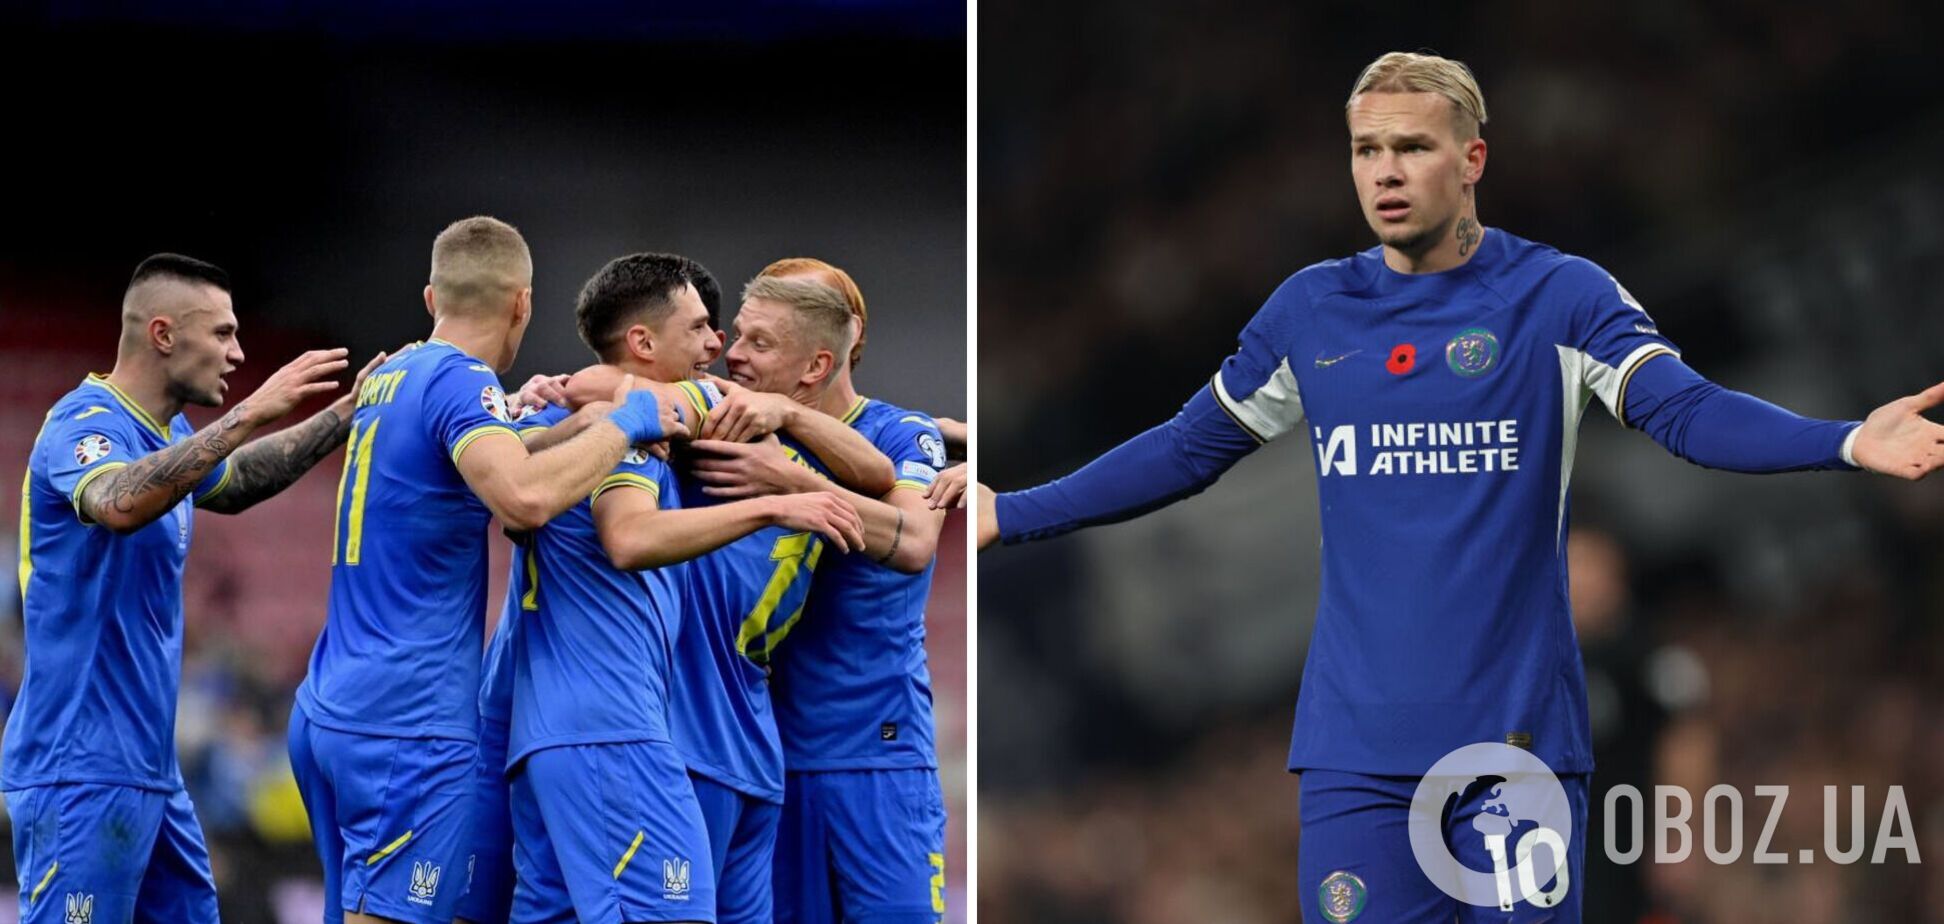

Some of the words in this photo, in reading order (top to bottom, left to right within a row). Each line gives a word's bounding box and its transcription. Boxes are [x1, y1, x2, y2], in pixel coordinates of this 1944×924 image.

[1371, 419, 1519, 447] INFINITE
[1369, 447, 1520, 476] ATHLETE
[1484, 827, 1570, 911] 10
